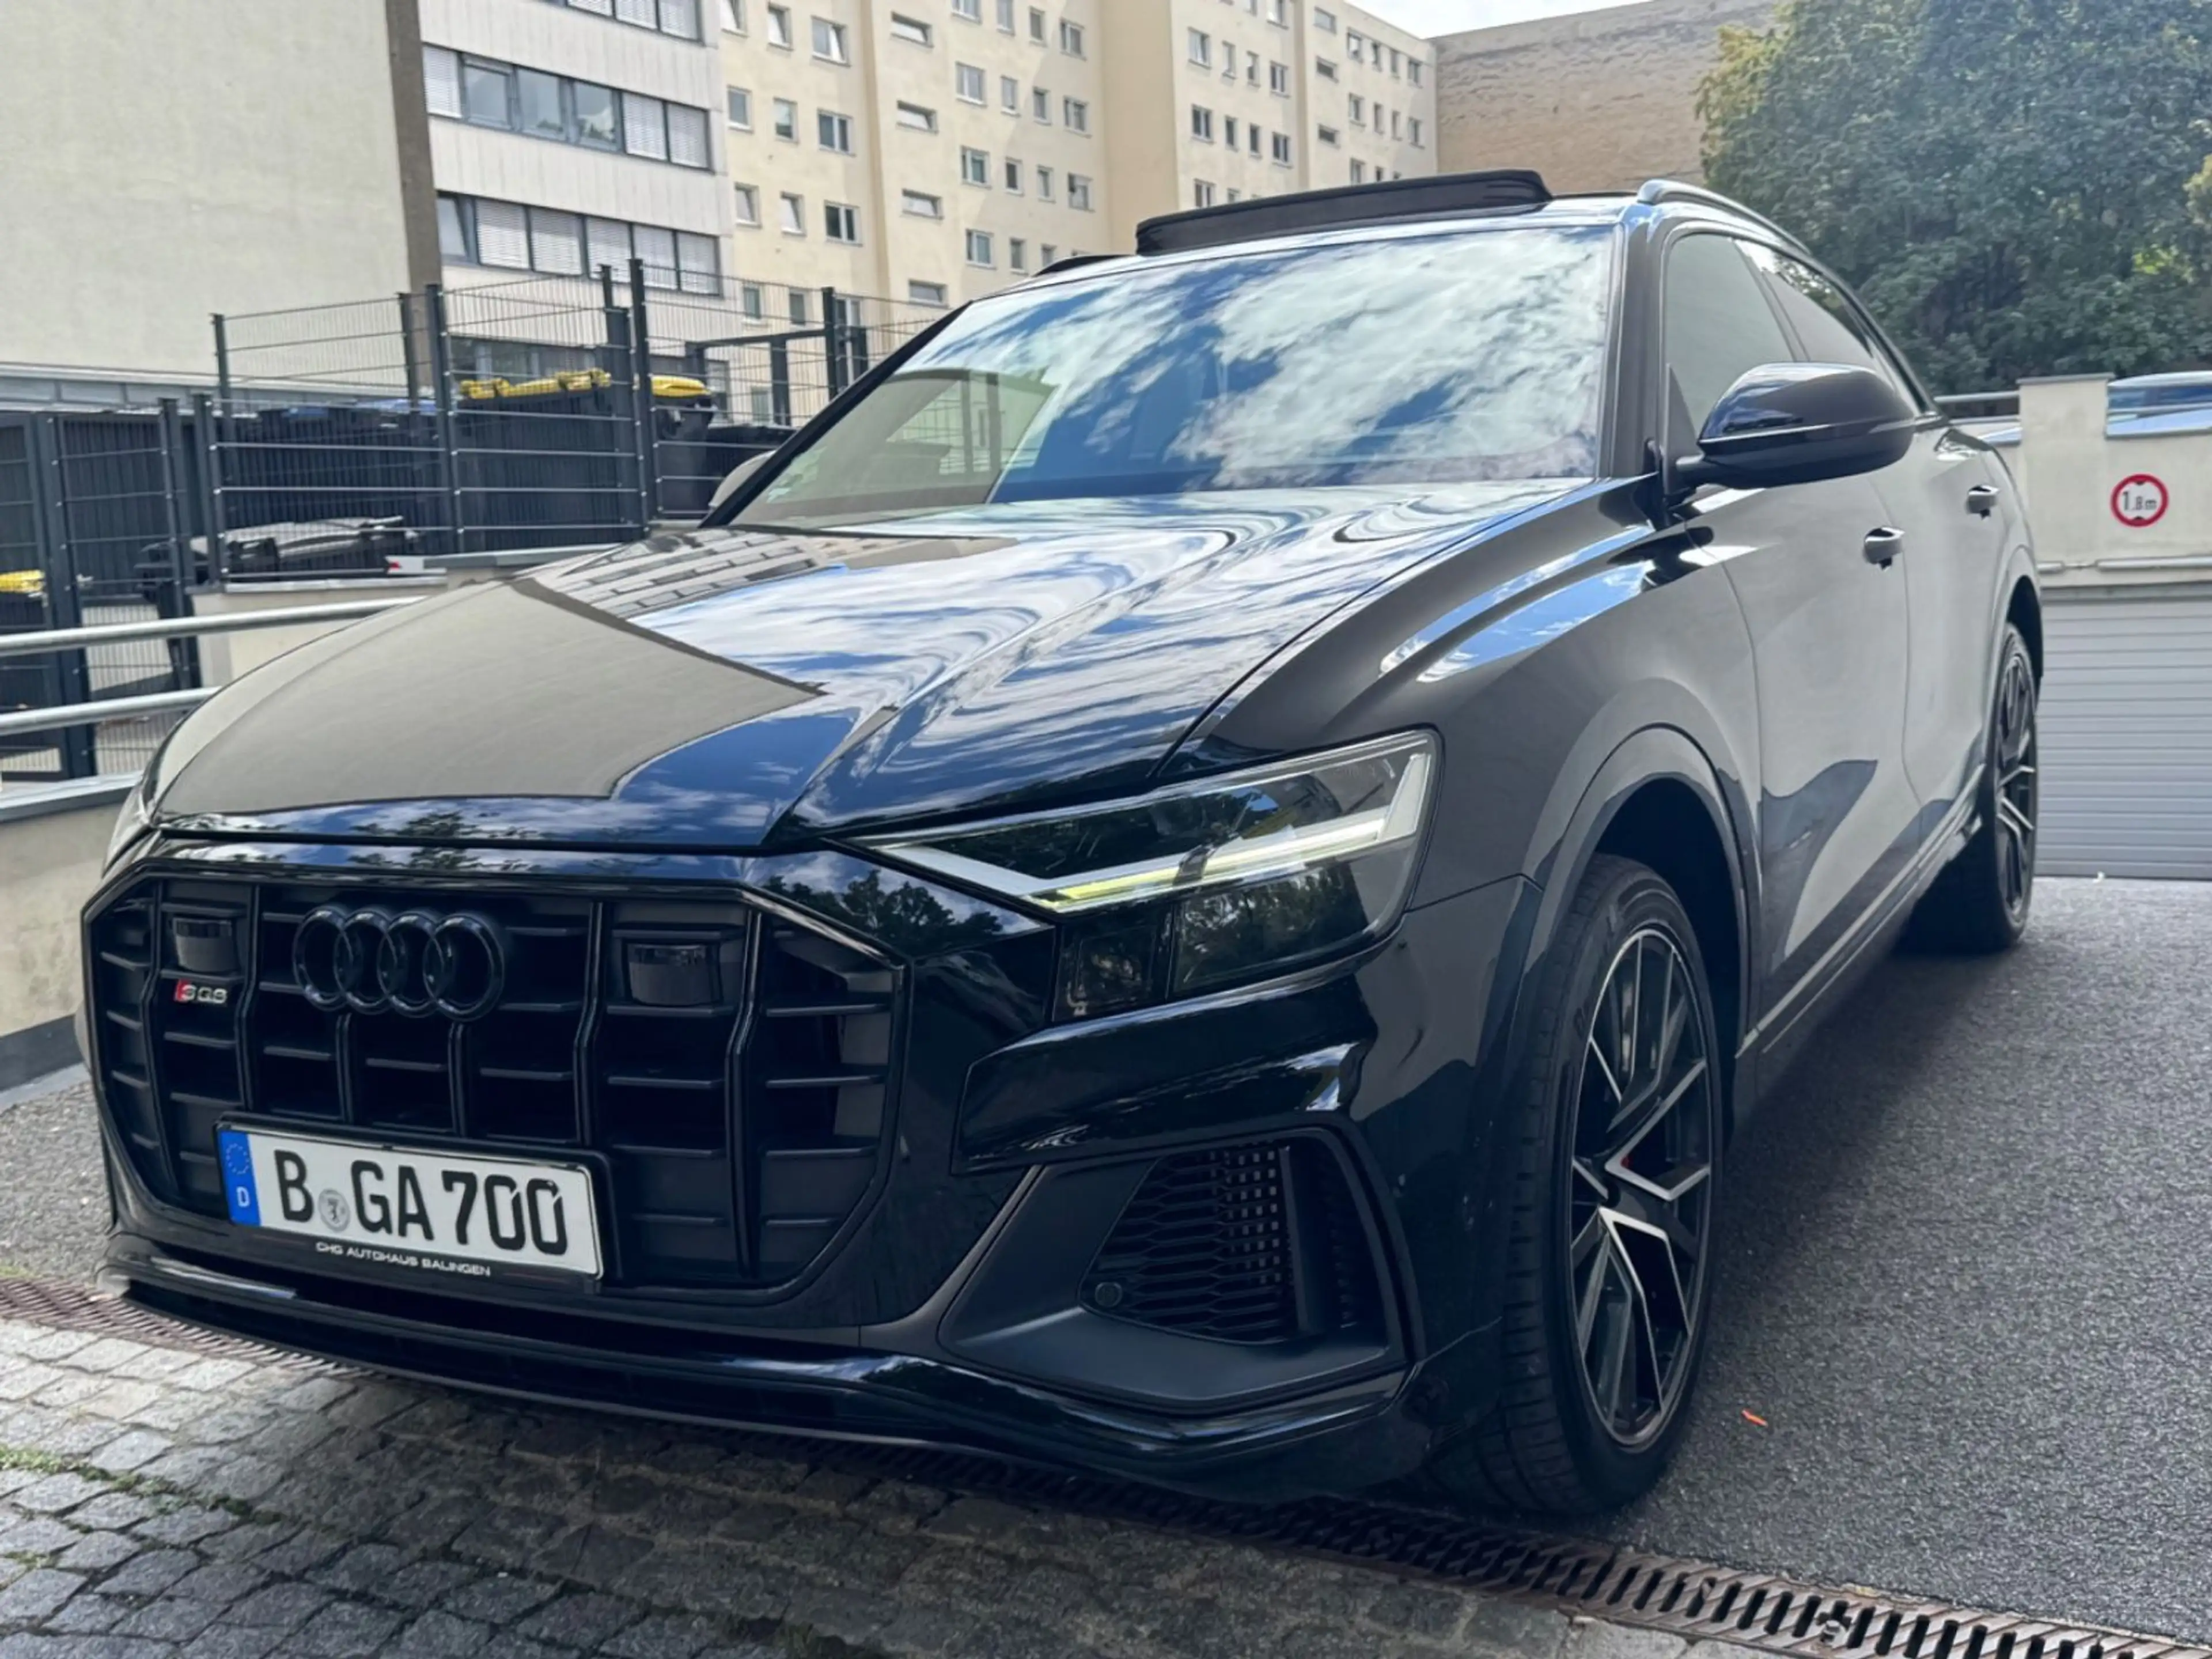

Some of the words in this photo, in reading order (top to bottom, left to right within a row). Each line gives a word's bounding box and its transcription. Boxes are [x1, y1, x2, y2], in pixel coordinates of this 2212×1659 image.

[236, 1185, 251, 1208] D
[274, 1150, 315, 1223] B
[351, 1159, 434, 1241] GA
[441, 1169, 568, 1256] 700
[346, 1247, 419, 1267] AUTOHAUS
[421, 1257, 491, 1277] BALINGEN
